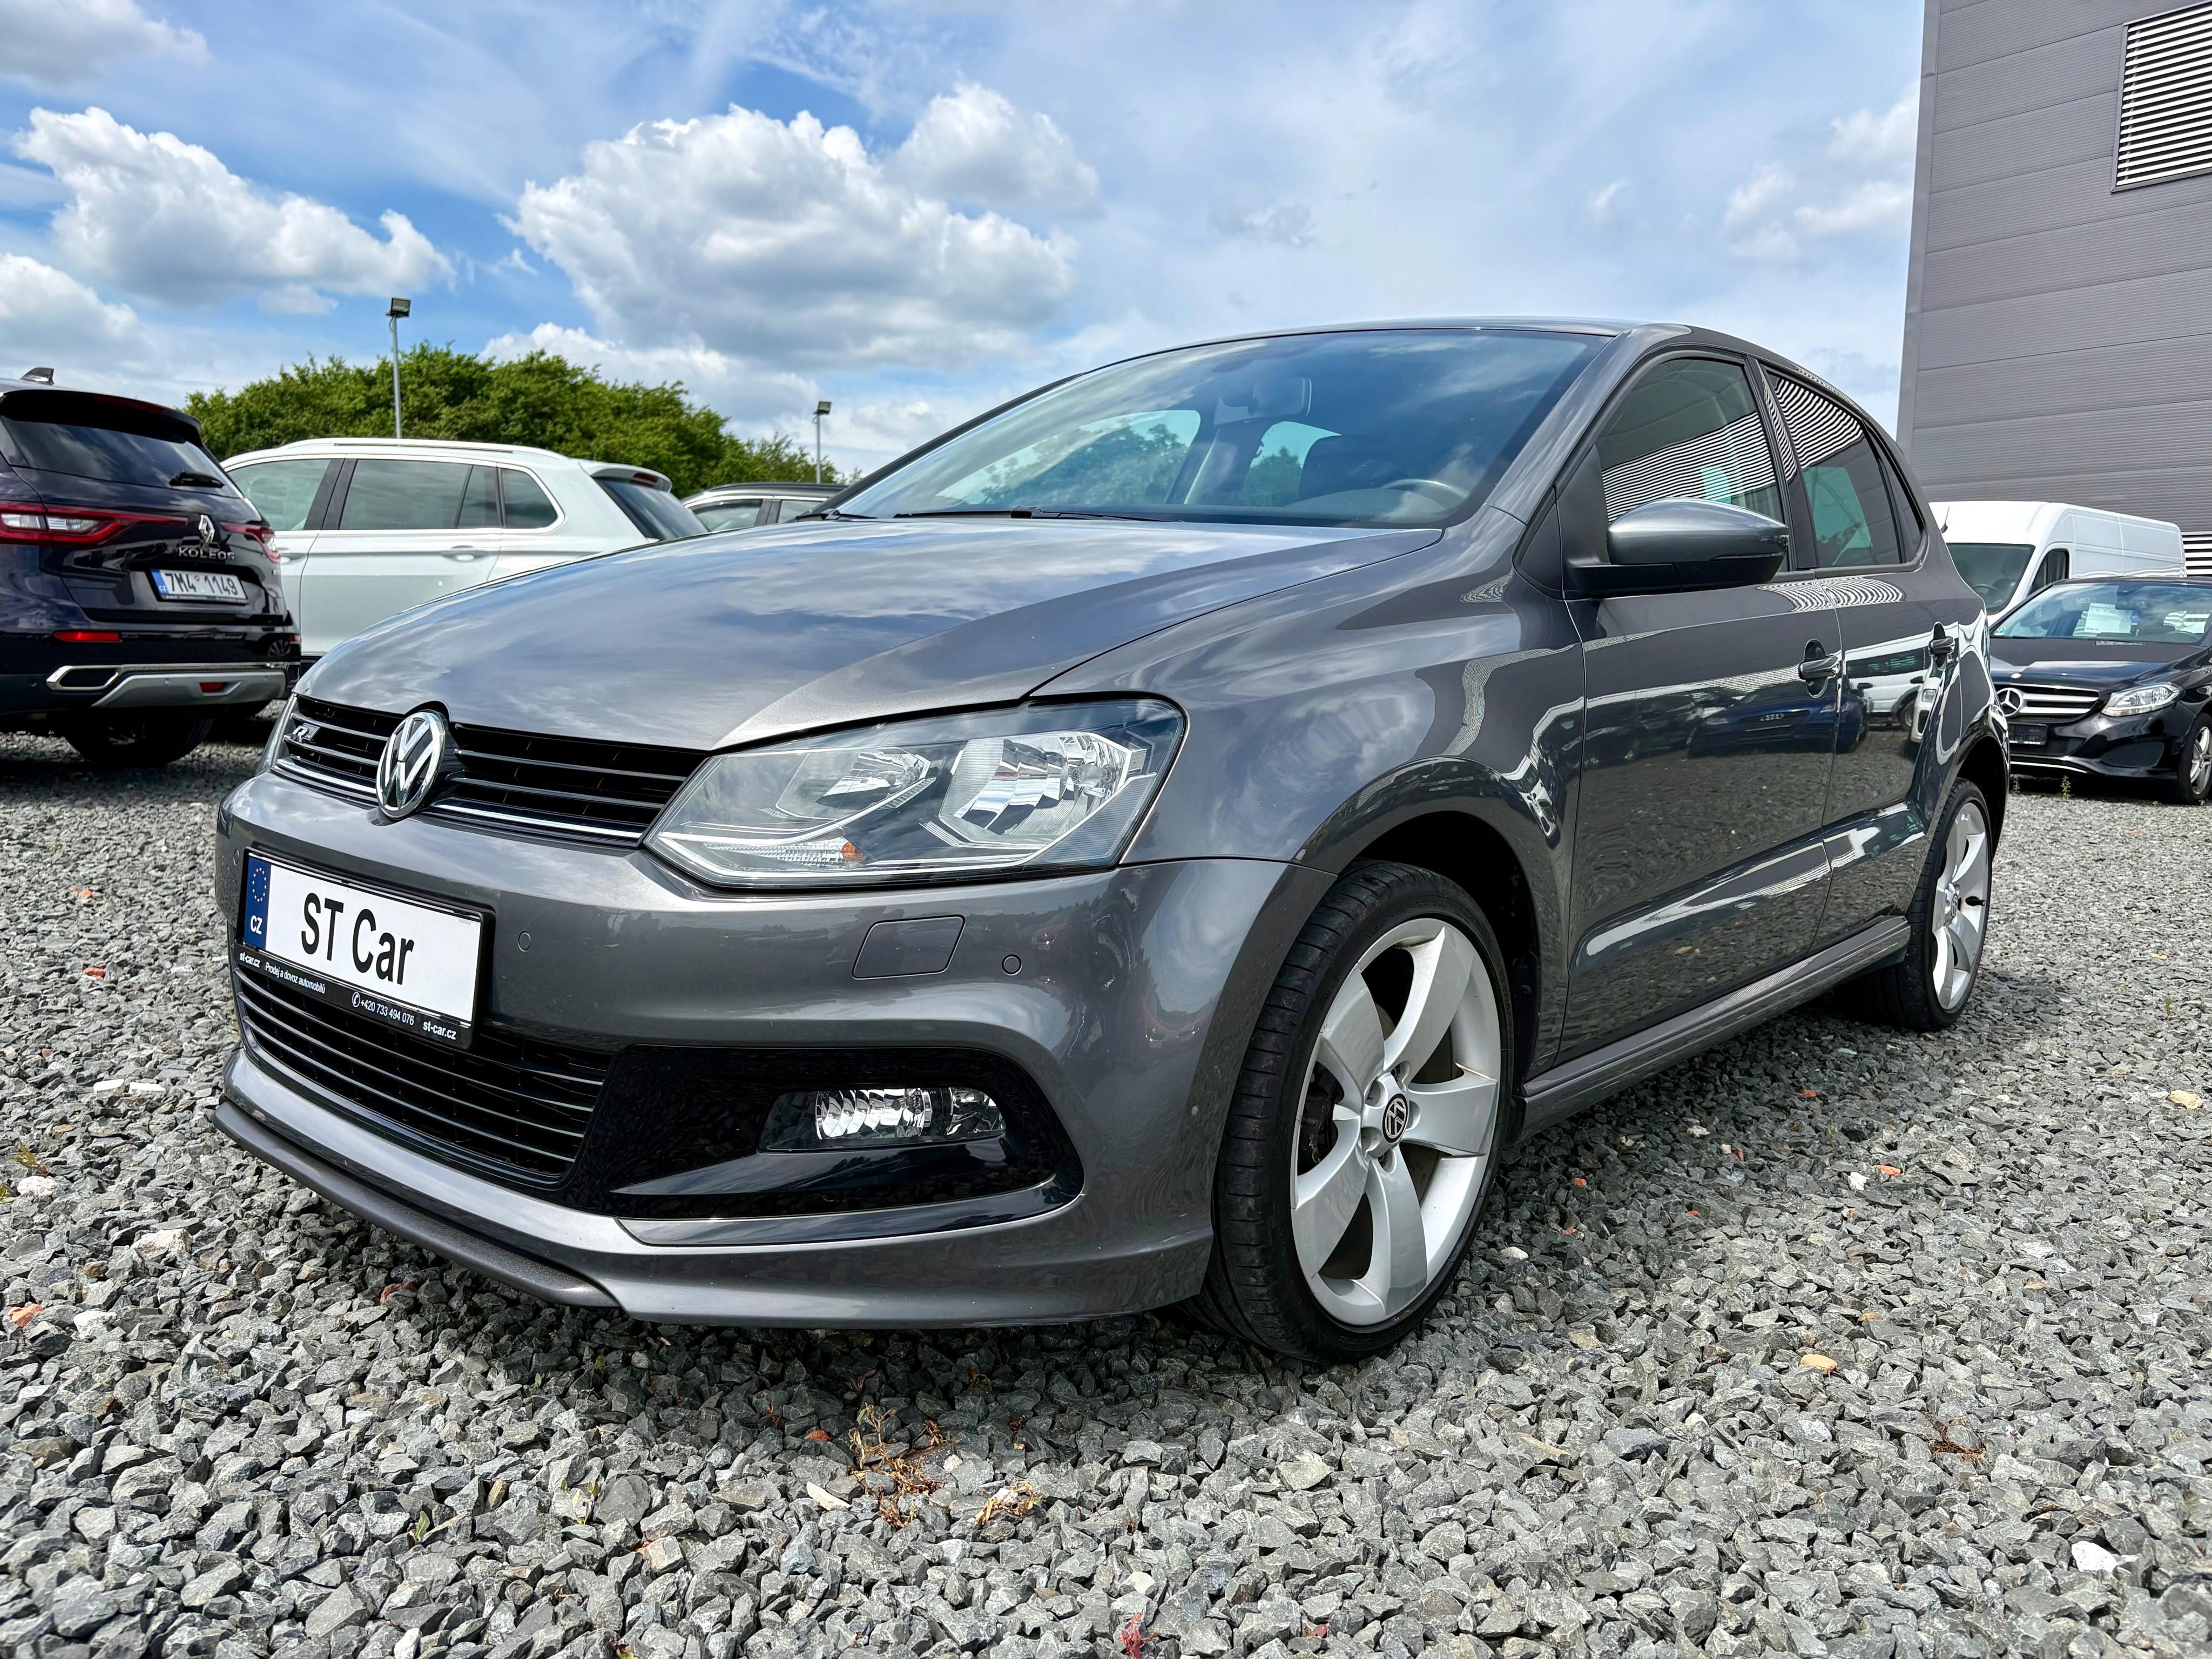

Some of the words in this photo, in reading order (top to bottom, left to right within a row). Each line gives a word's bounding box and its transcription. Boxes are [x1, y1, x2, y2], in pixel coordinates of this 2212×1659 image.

[179, 547, 235, 559] KOLEOS
[165, 573, 197, 592] 7M4
[204, 575, 238, 595] 1149
[250, 915, 262, 935] CZ
[301, 892, 344, 961] ST
[352, 908, 415, 986] Car
[239, 952, 260, 968] st-car.cz
[265, 962, 280, 979] Prodej
[284, 970, 299, 983] dovoz
[361, 1000, 375, 1013] +420
[376, 1003, 388, 1016] 733
[389, 1008, 401, 1021] 494
[402, 1013, 415, 1026] 076
[423, 1021, 457, 1040] st-car.cz
